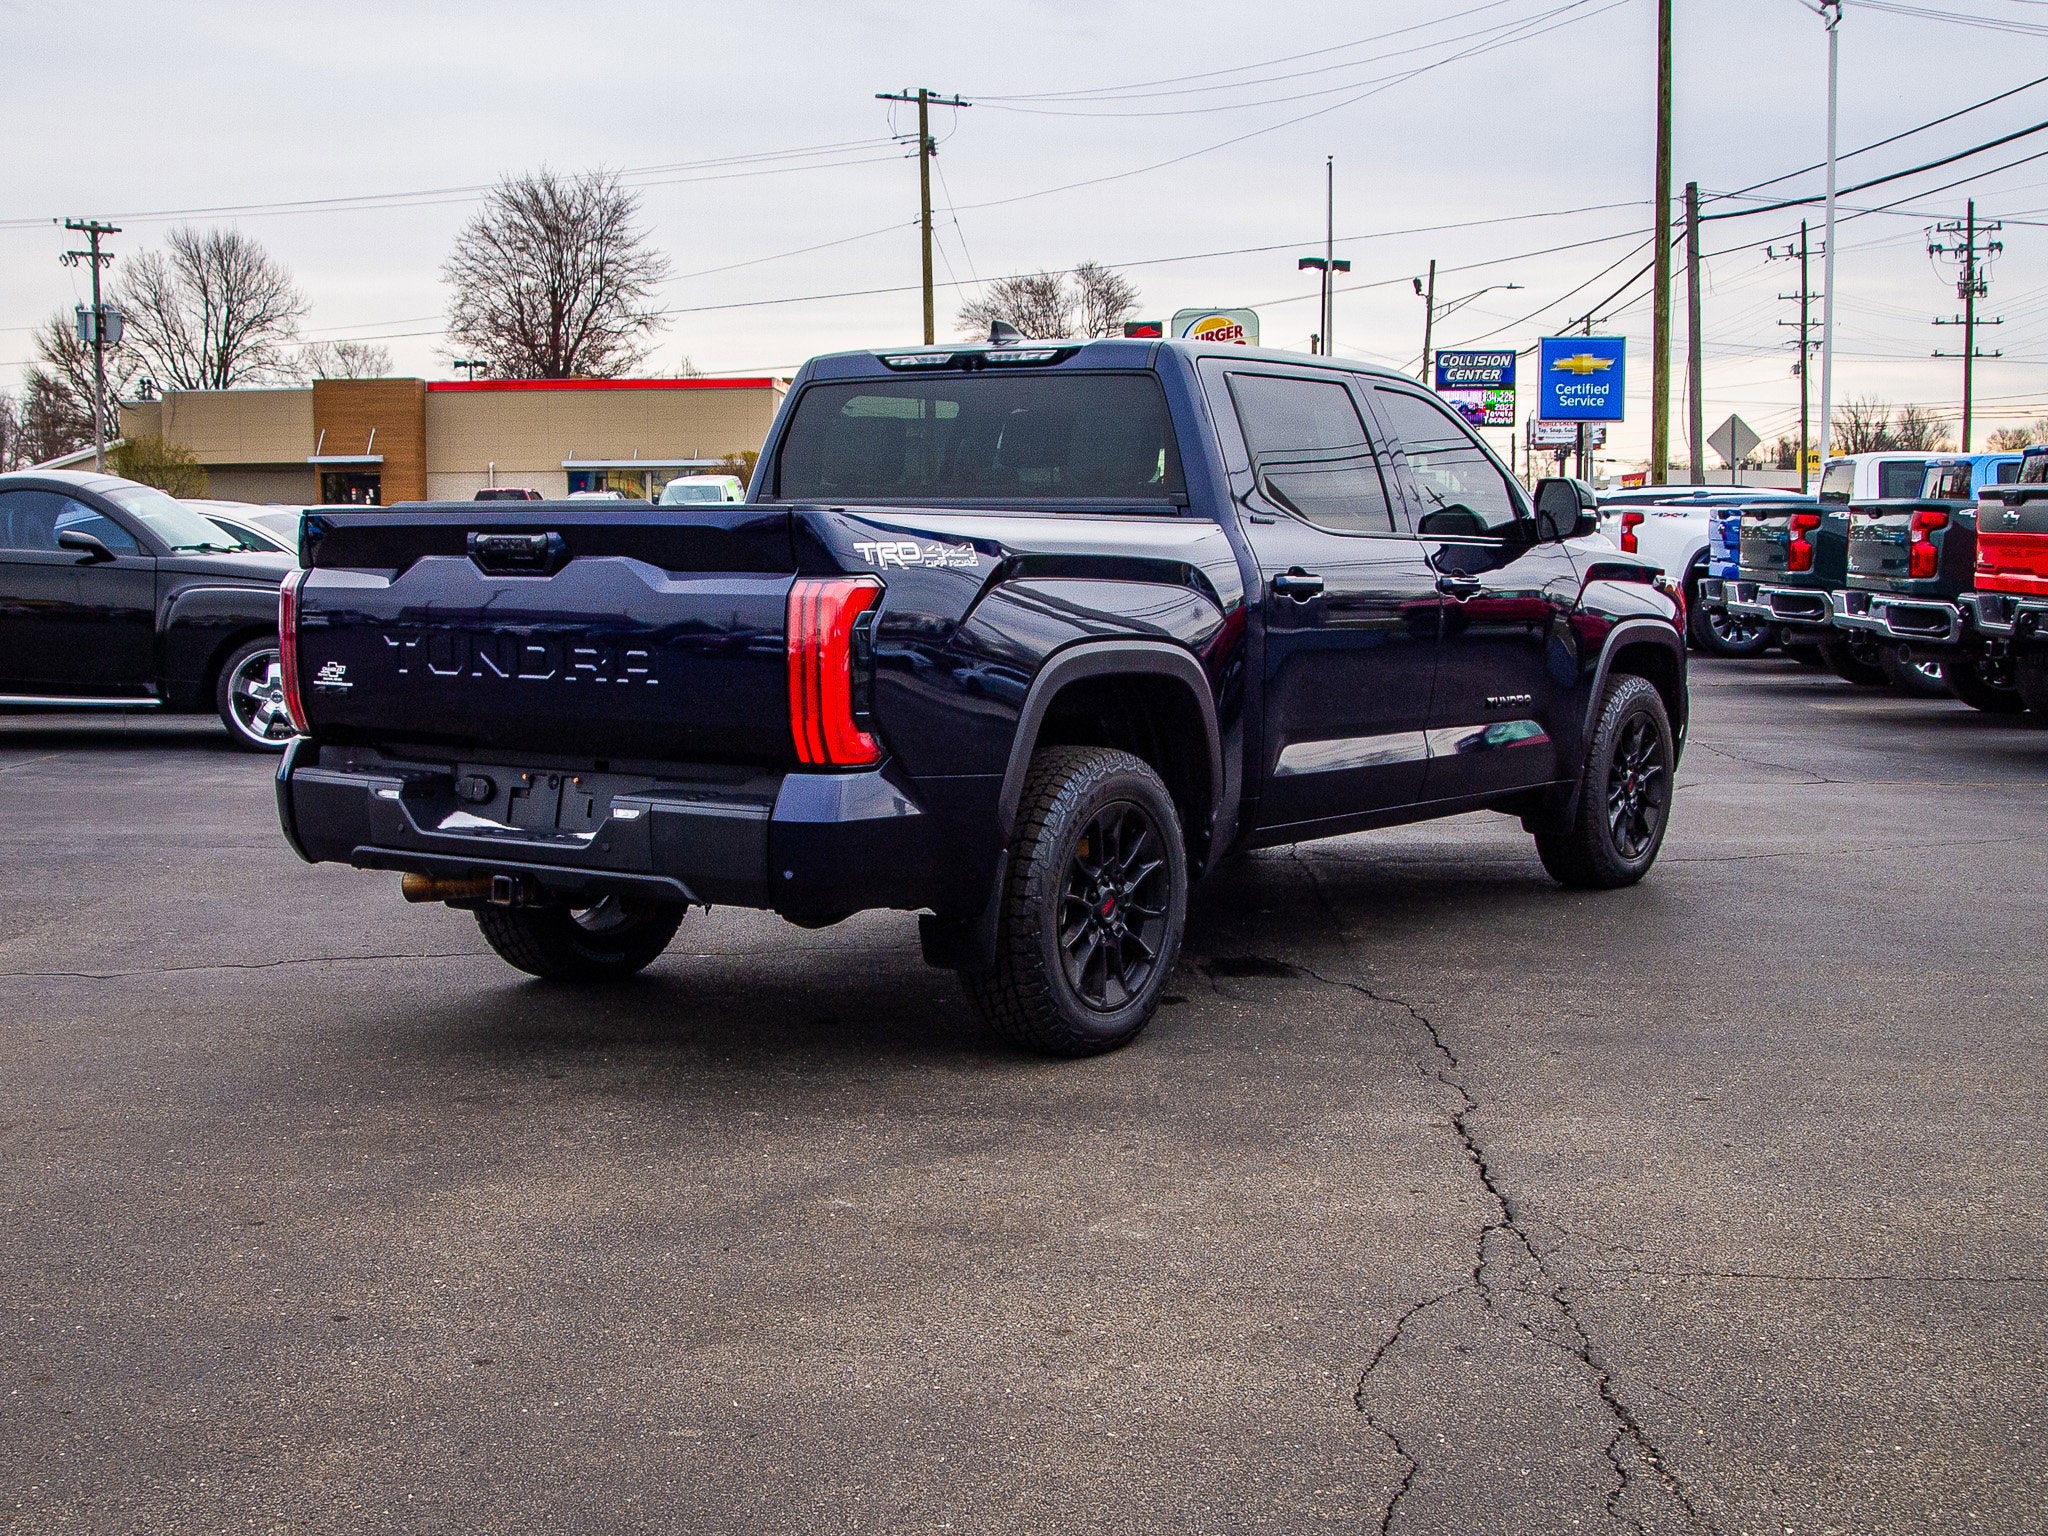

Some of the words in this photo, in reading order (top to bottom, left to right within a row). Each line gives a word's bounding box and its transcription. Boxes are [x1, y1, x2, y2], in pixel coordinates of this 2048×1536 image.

[1194, 325, 1244, 342] RGER
[1439, 354, 1512, 367] COLLISION
[1446, 368, 1501, 380] CENTER
[1555, 383, 1610, 395] Certified
[1559, 395, 1605, 406] Service
[853, 541, 924, 570] TRD
[383, 635, 659, 684] TUNDRA
